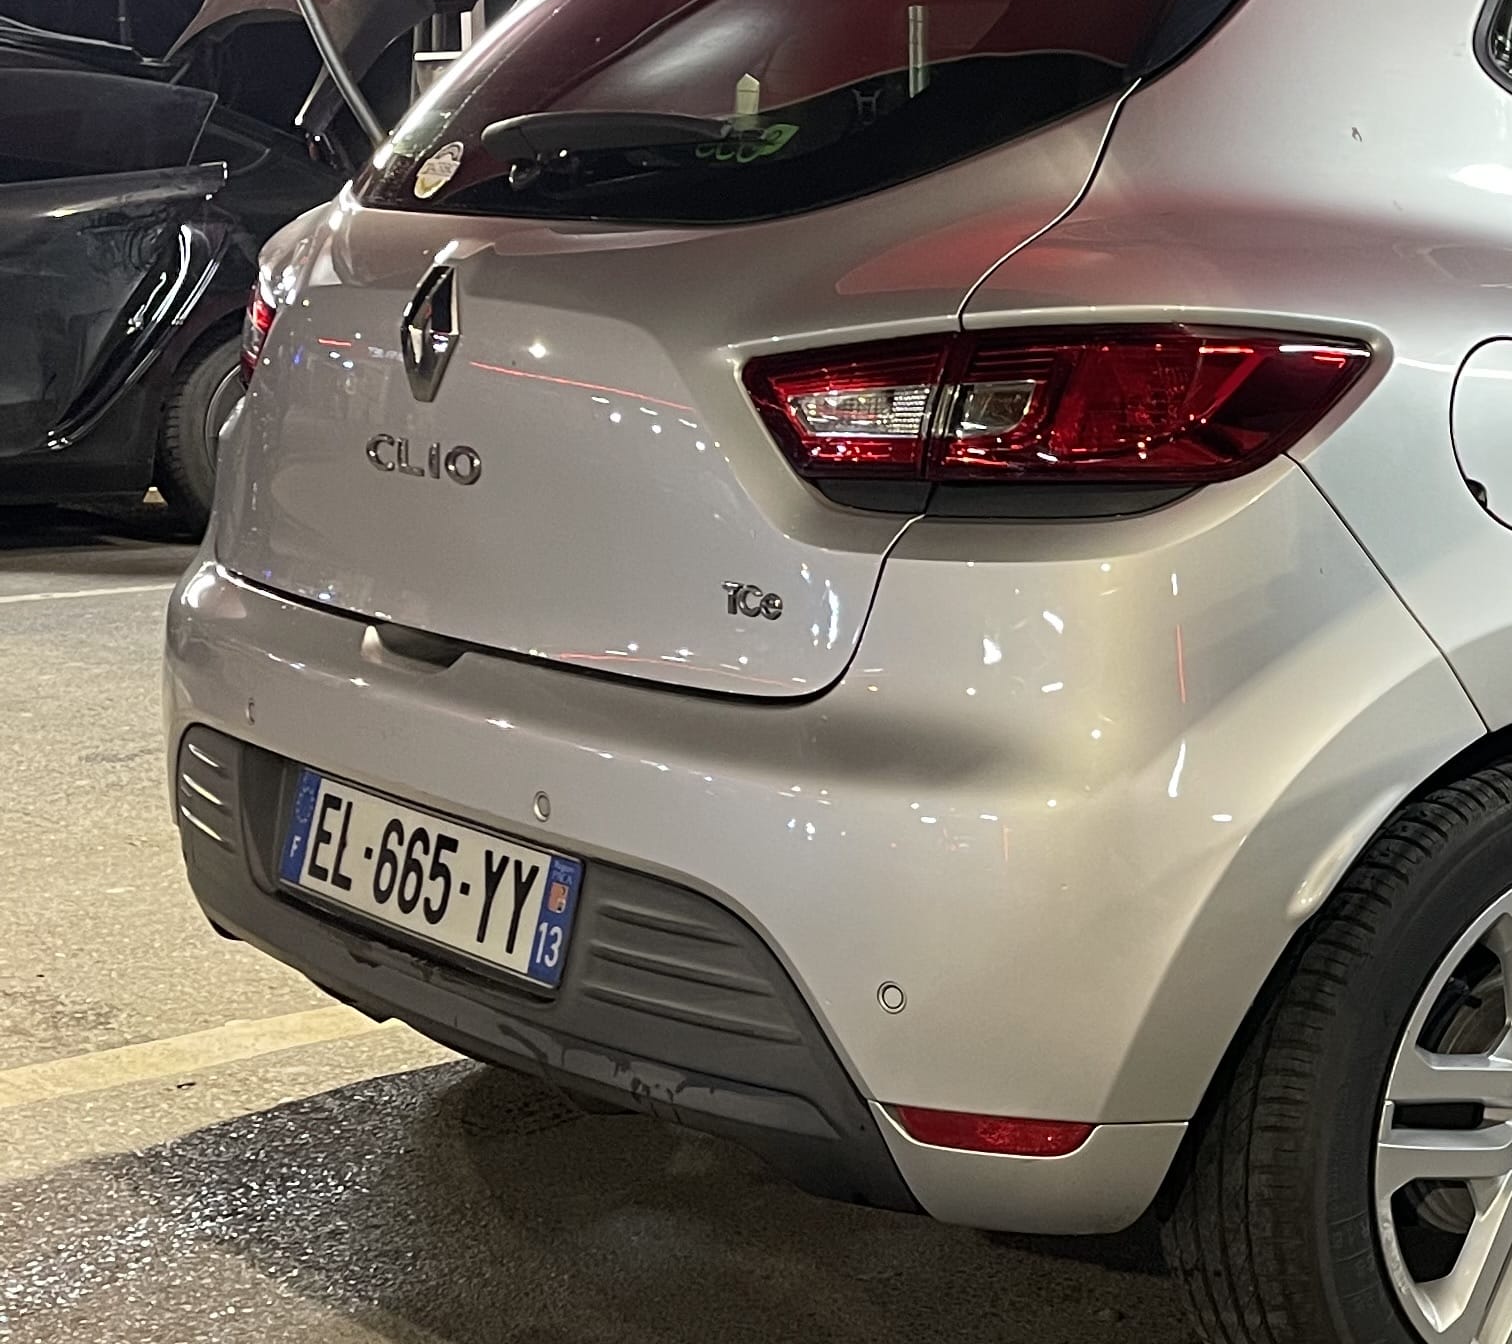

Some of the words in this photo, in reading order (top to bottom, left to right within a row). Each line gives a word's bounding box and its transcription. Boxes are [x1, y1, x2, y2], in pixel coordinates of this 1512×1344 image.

[365, 433, 482, 486] CLIO
[721, 580, 784, 621] TCe
[290, 835, 301, 858] F
[308, 792, 540, 955] EL-665-YY
[535, 921, 563, 967] 13
